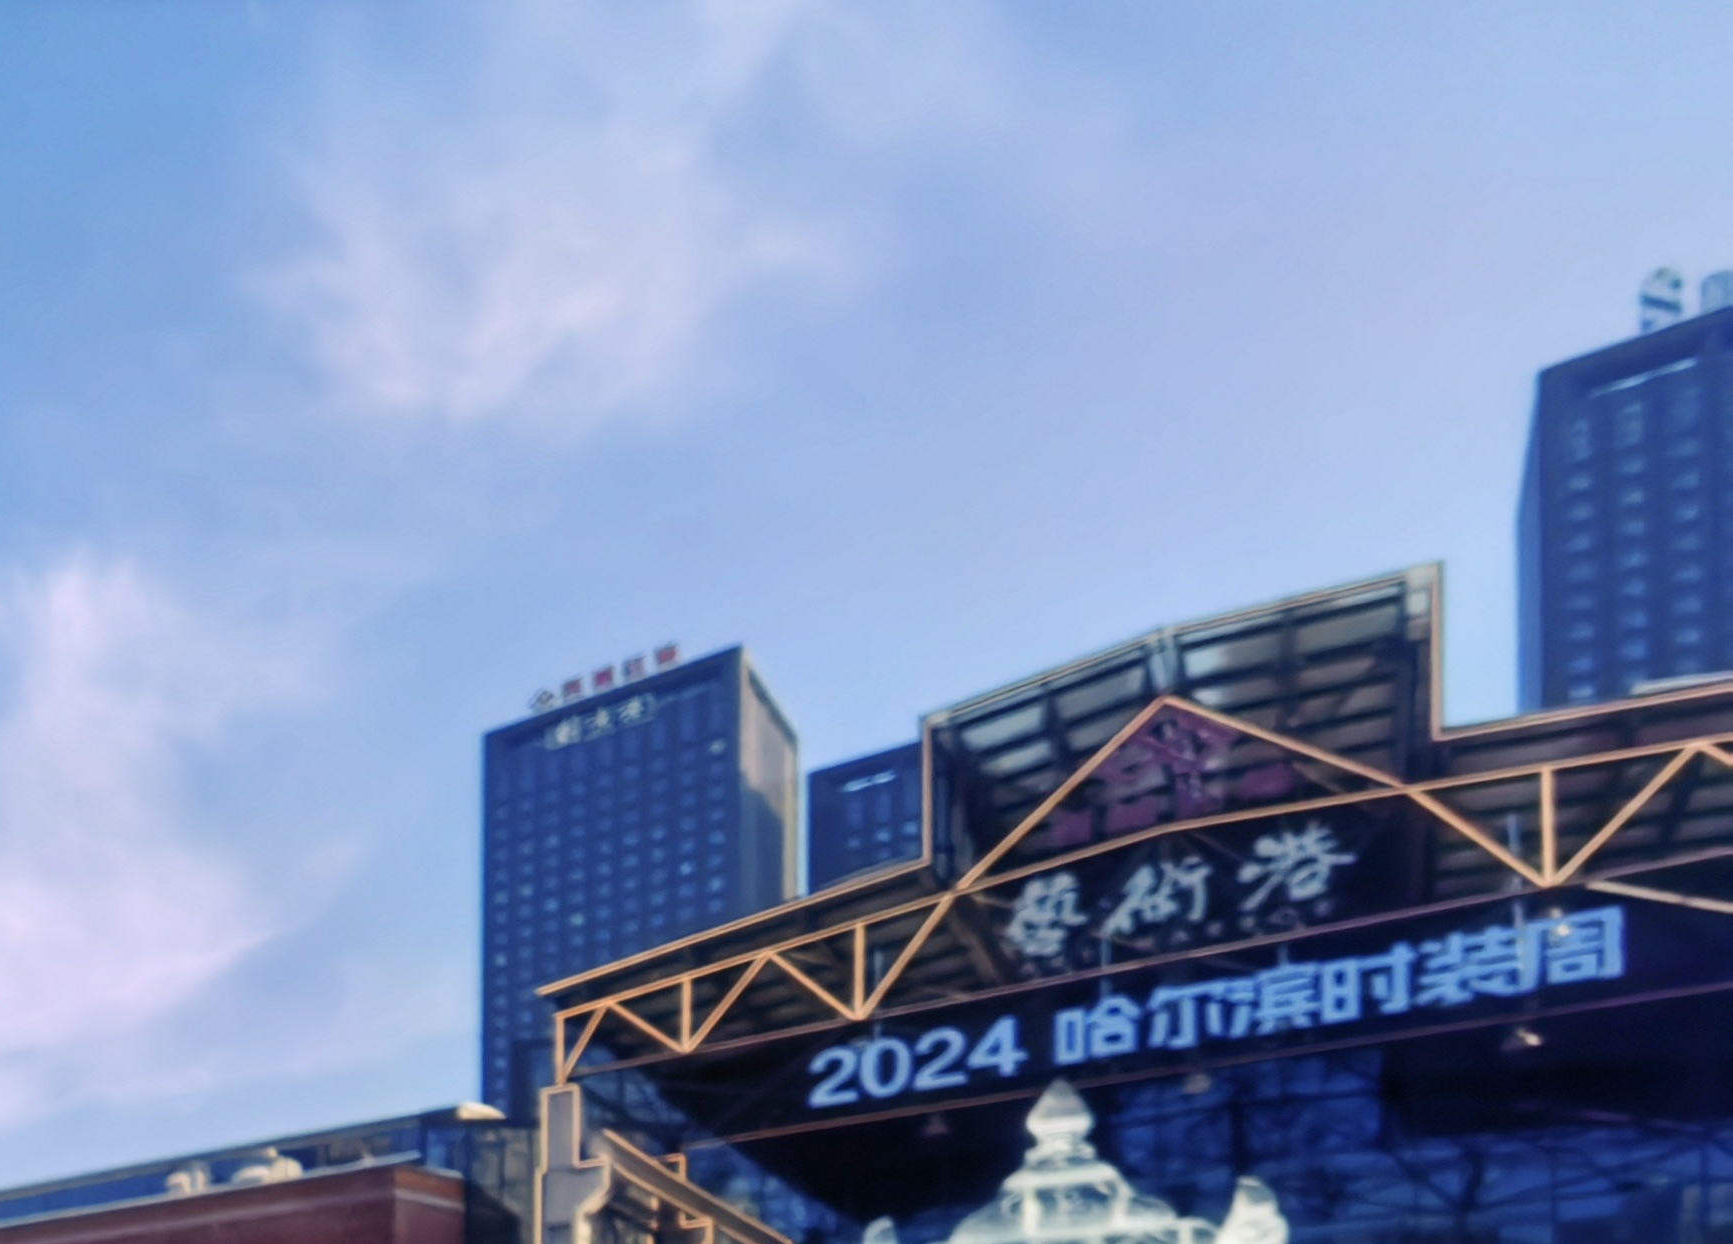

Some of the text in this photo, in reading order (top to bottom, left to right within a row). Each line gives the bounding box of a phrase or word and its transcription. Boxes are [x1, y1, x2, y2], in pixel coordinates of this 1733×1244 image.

[808, 1014, 1029, 1108] 2024
[1054, 904, 1625, 1065] 哈尔滨时装周
